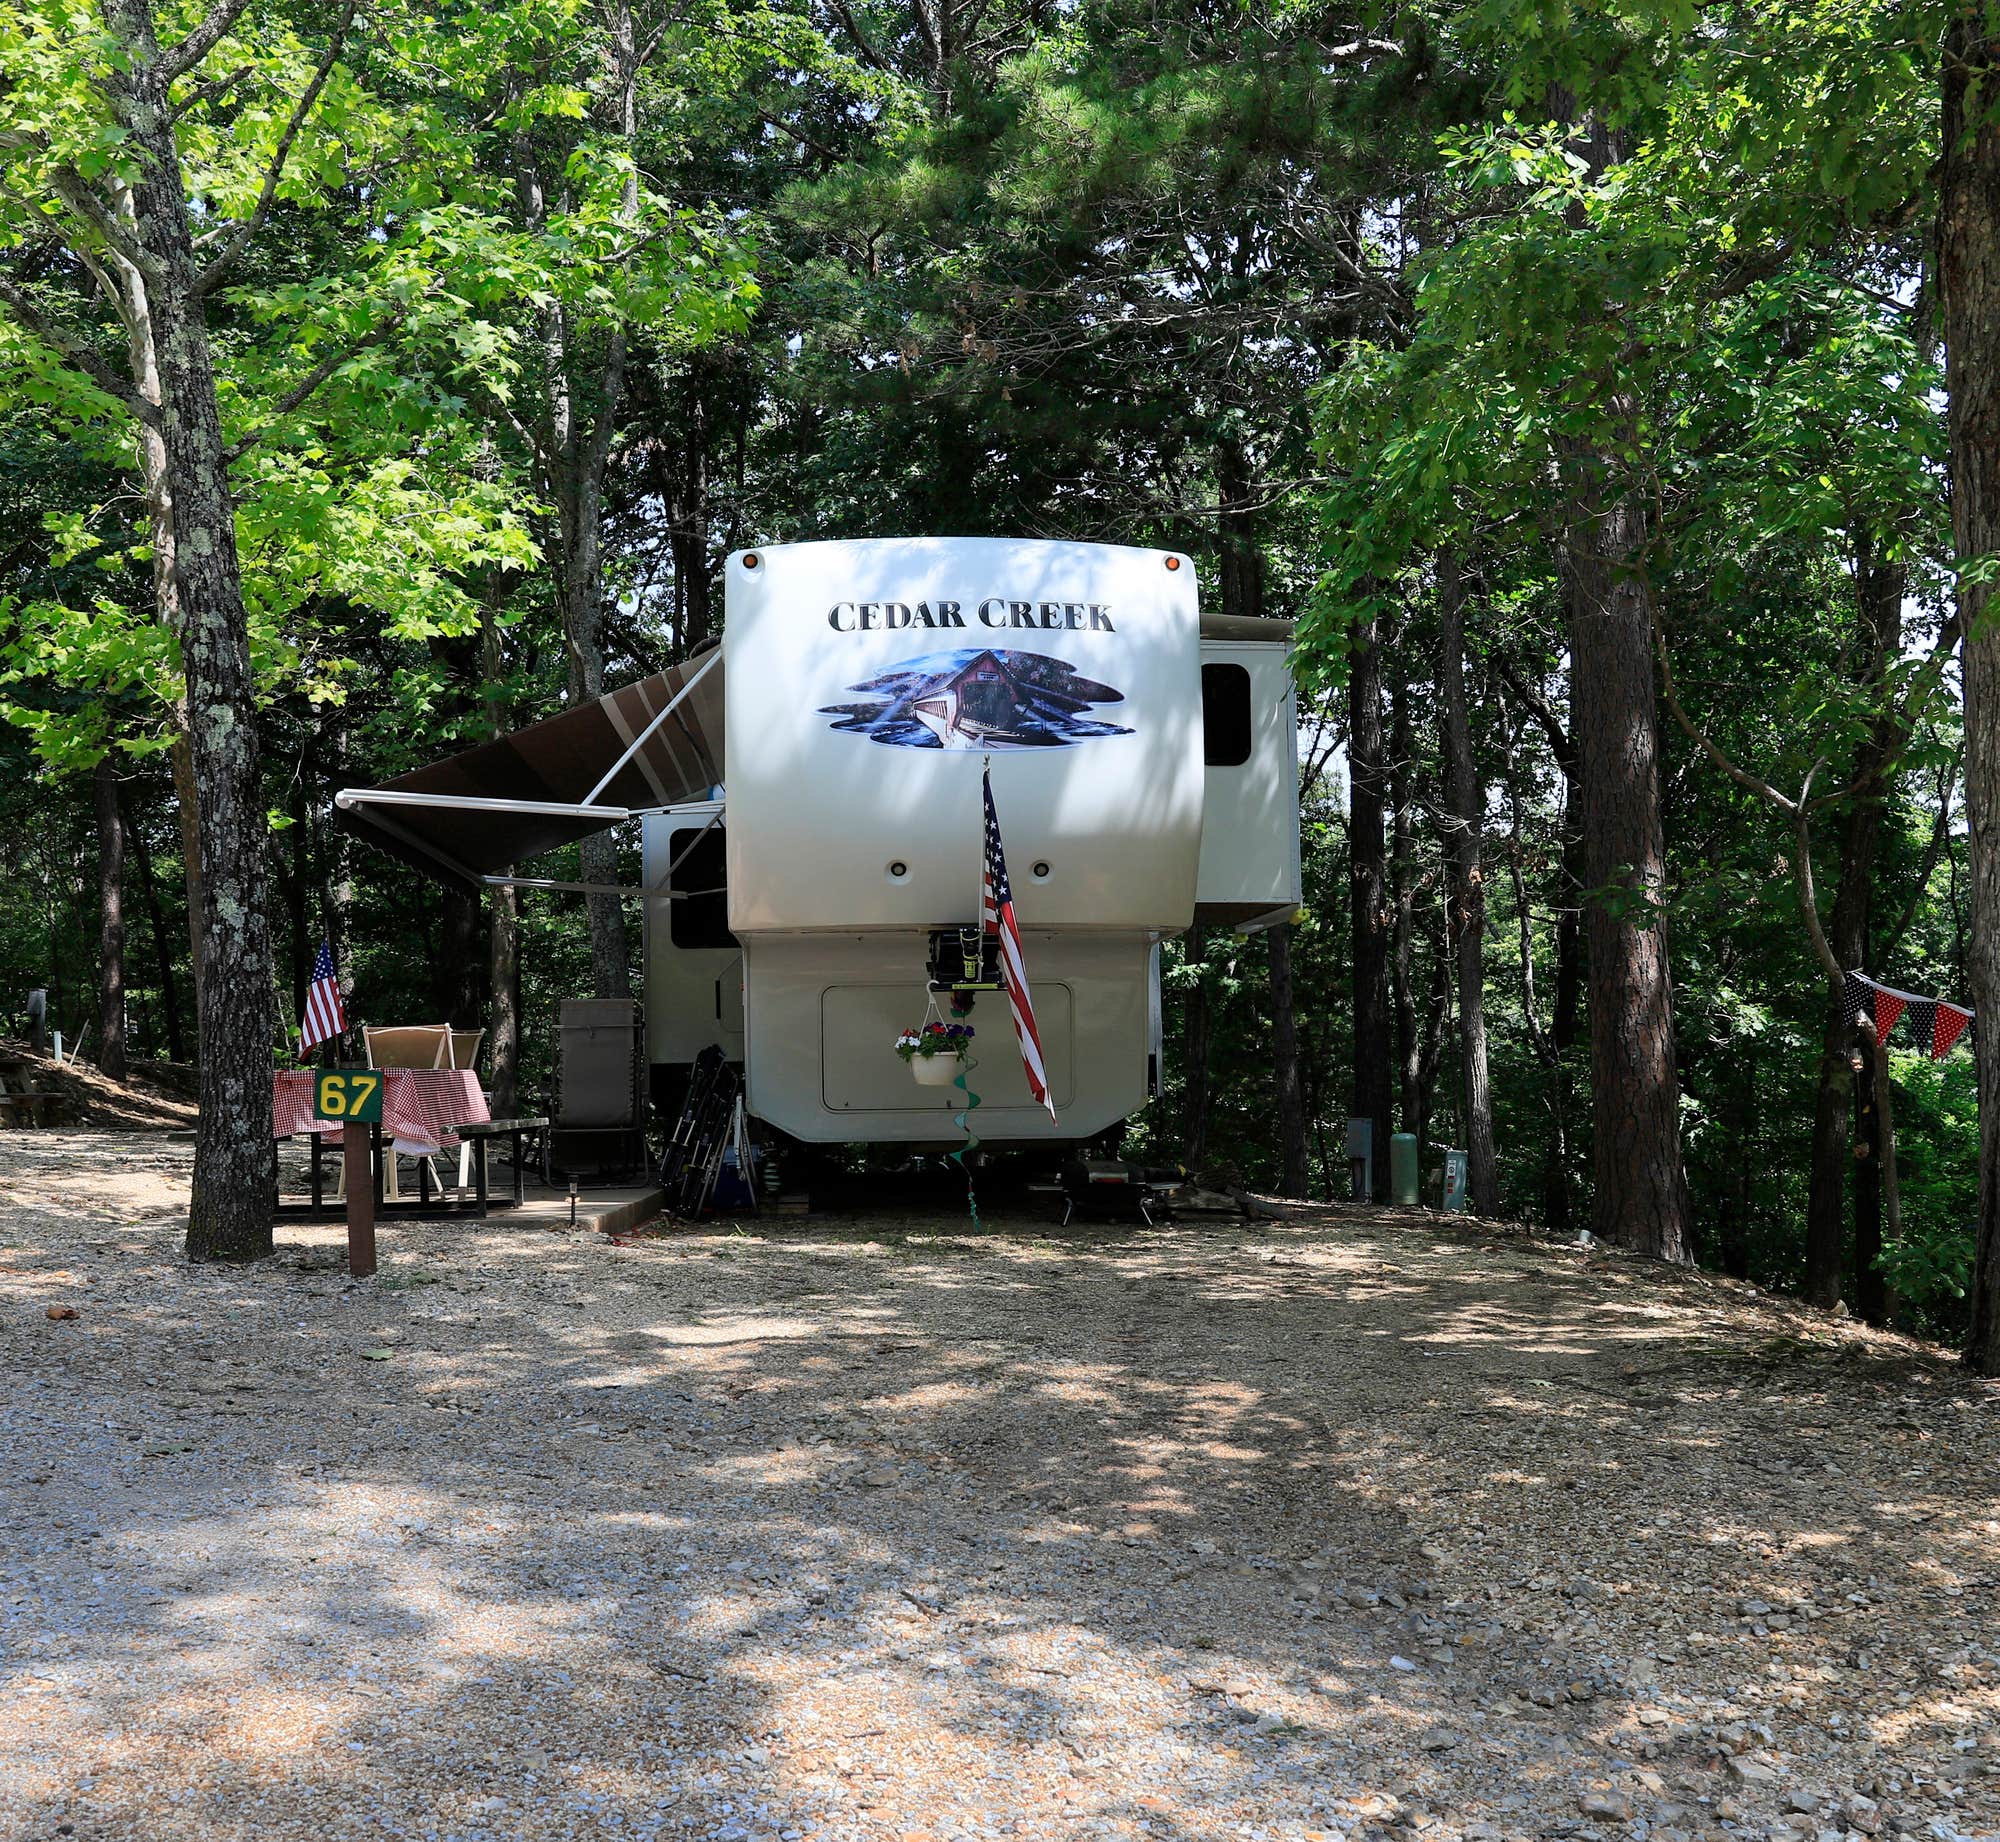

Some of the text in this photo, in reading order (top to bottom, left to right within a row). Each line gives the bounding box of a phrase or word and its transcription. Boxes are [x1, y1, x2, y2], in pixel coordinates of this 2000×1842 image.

[827, 598, 1116, 633] CEDAR CREEK
[320, 1075, 377, 1116] 67
